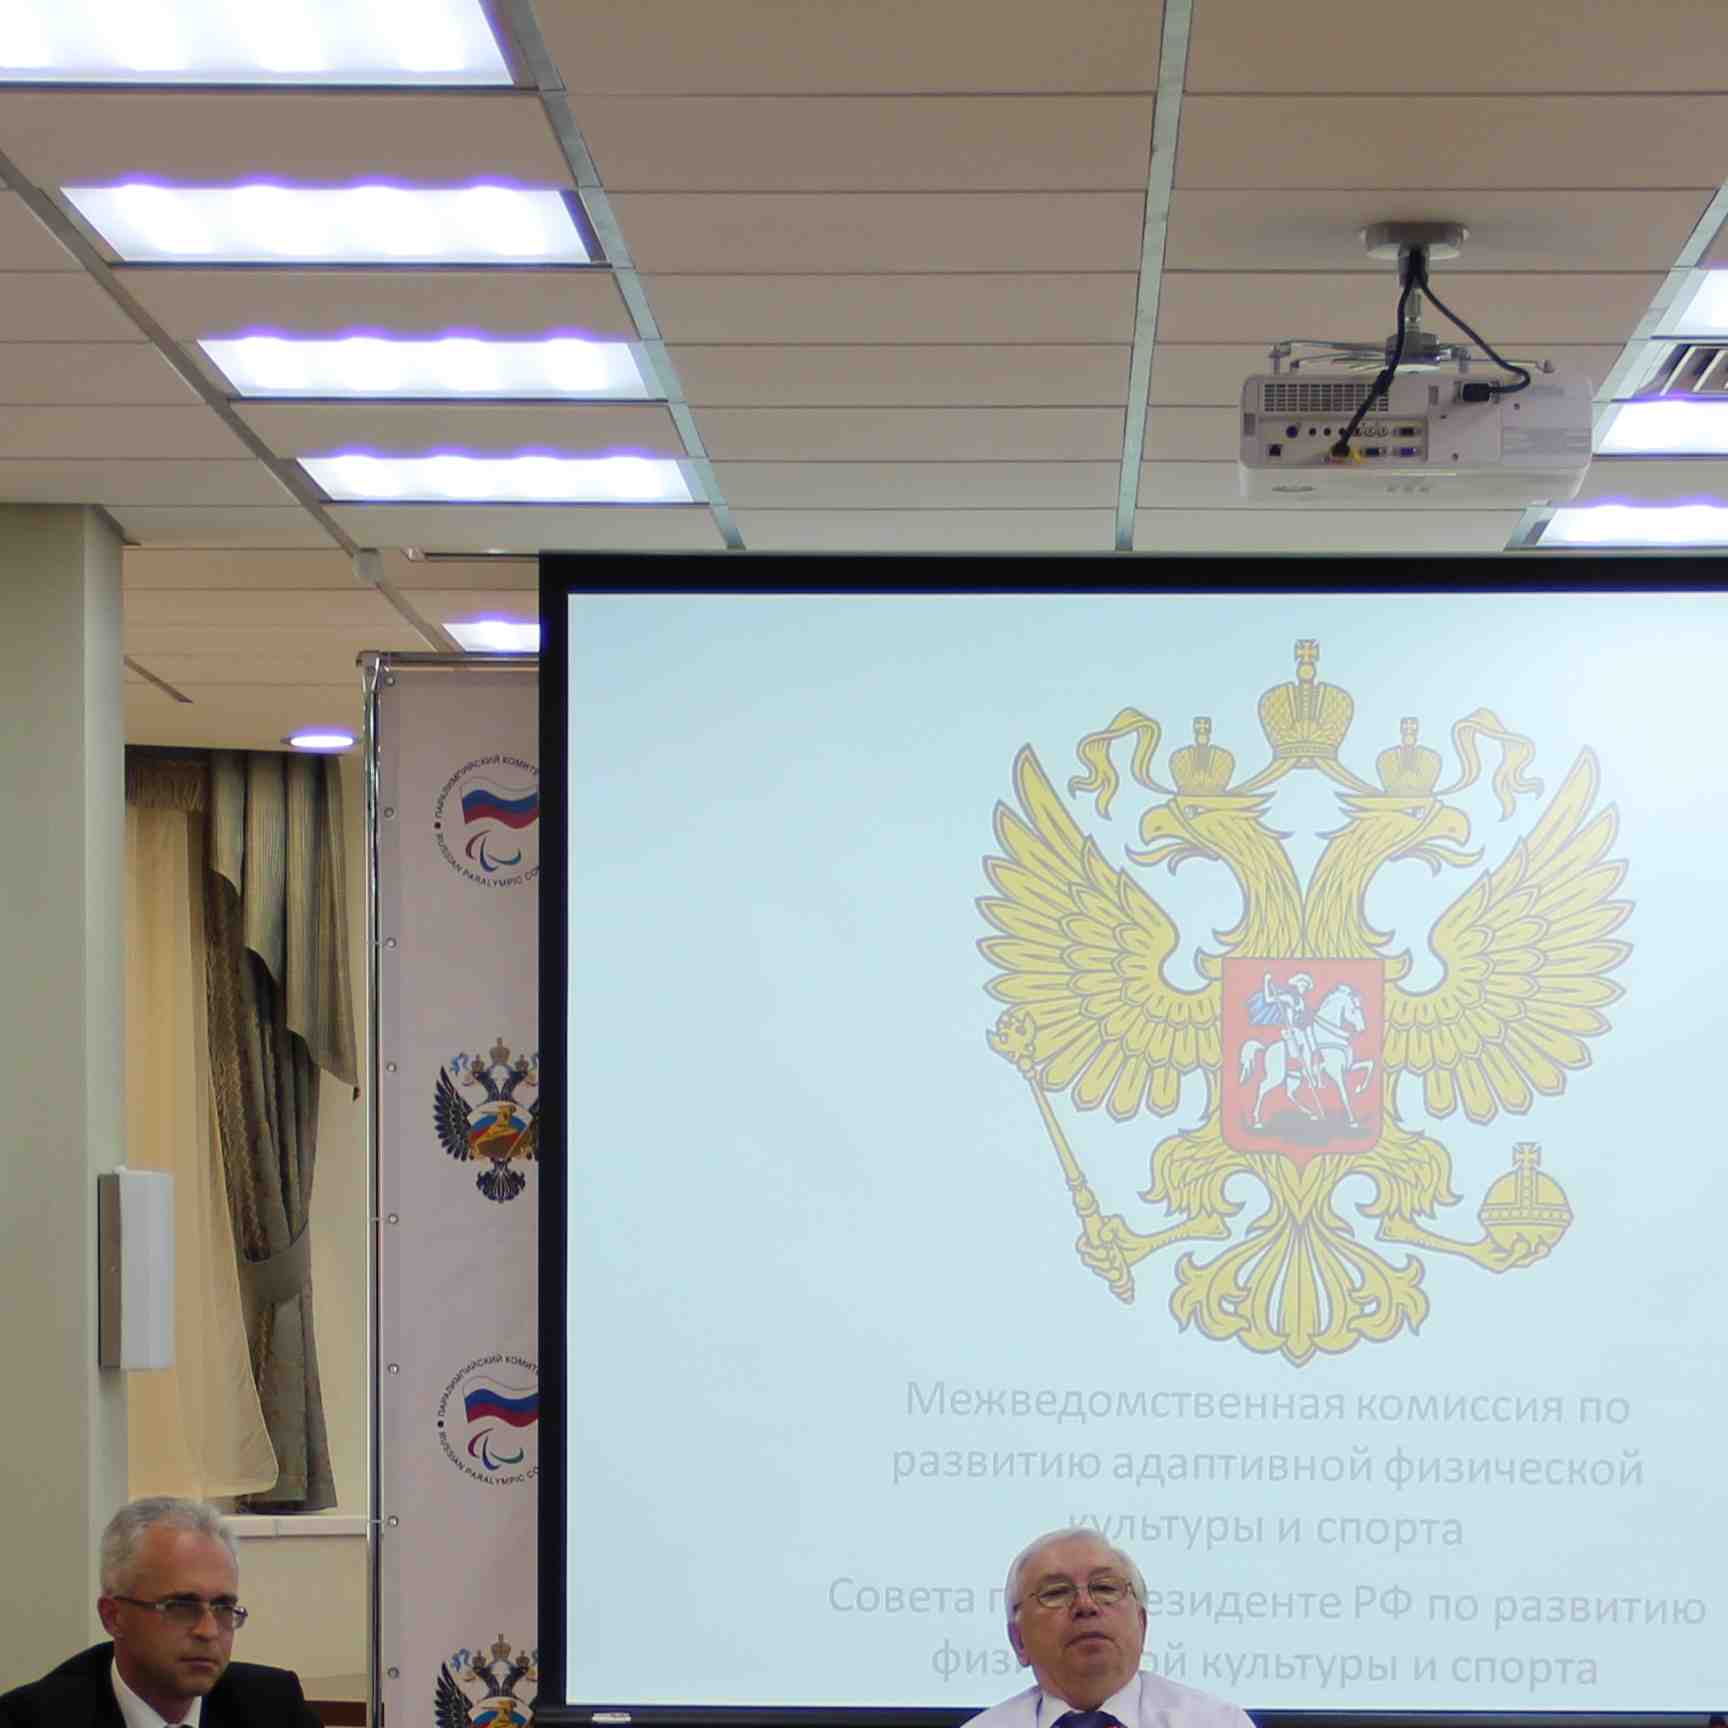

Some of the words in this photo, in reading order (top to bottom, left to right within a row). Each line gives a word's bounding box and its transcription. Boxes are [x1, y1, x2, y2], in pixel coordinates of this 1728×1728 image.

[905, 1379, 1345, 1425] Межведомственная
[1357, 1392, 1563, 1424] комиссия
[1578, 1395, 1631, 1425] по
[892, 1449, 1103, 1485] развитию
[1112, 1443, 1373, 1487] адаптивной
[1384, 1444, 1644, 1491] физической
[1278, 1516, 1301, 1544] и
[1316, 1516, 1464, 1553] спорта
[828, 1576, 975, 1615] Совета
[1148, 1584, 1342, 1626] езиденте
[1353, 1583, 1412, 1621] РФ
[1428, 1593, 1478, 1623] по
[1494, 1592, 1707, 1631] развитию
[1202, 1650, 1398, 1689] культуры
[1414, 1655, 1437, 1681] и
[1451, 1656, 1599, 1693] спорта
